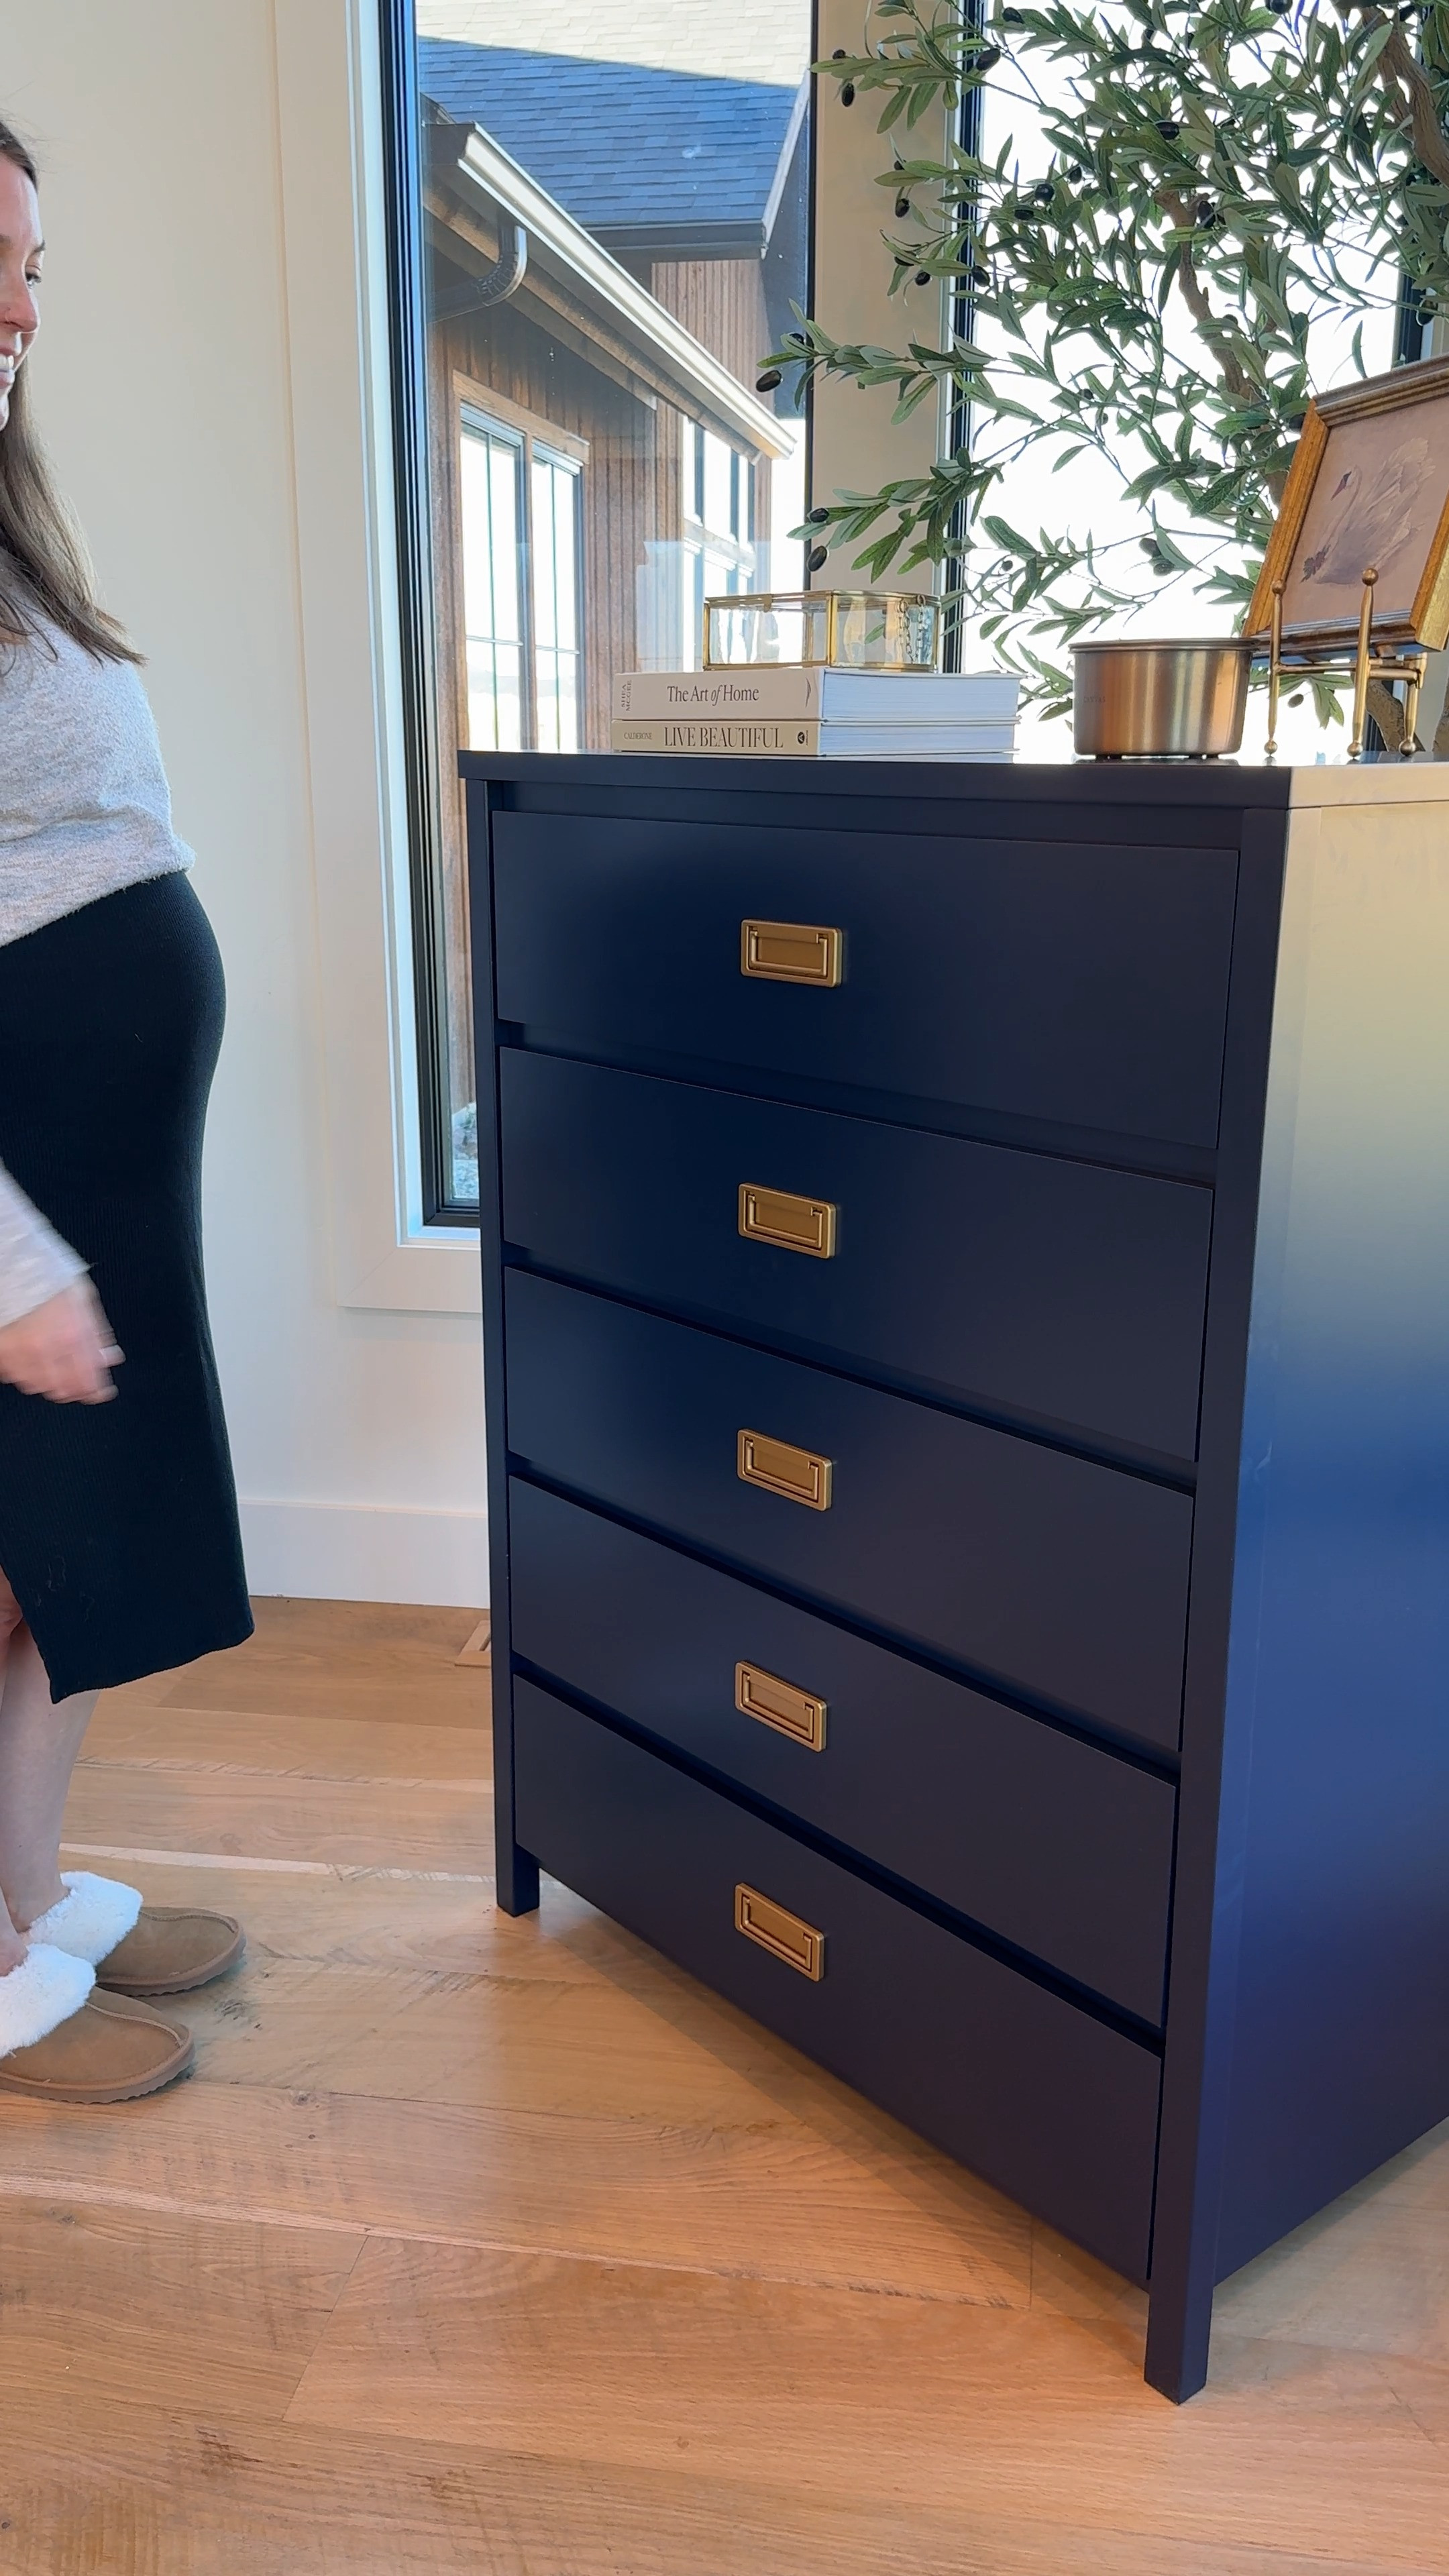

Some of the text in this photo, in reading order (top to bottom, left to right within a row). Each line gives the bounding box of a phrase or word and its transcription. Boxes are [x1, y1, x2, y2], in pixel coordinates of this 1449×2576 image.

[667, 684, 759, 706] The Art of Home
[664, 727, 696, 747] LIVE
[699, 727, 784, 748] BEAUTIFUL
